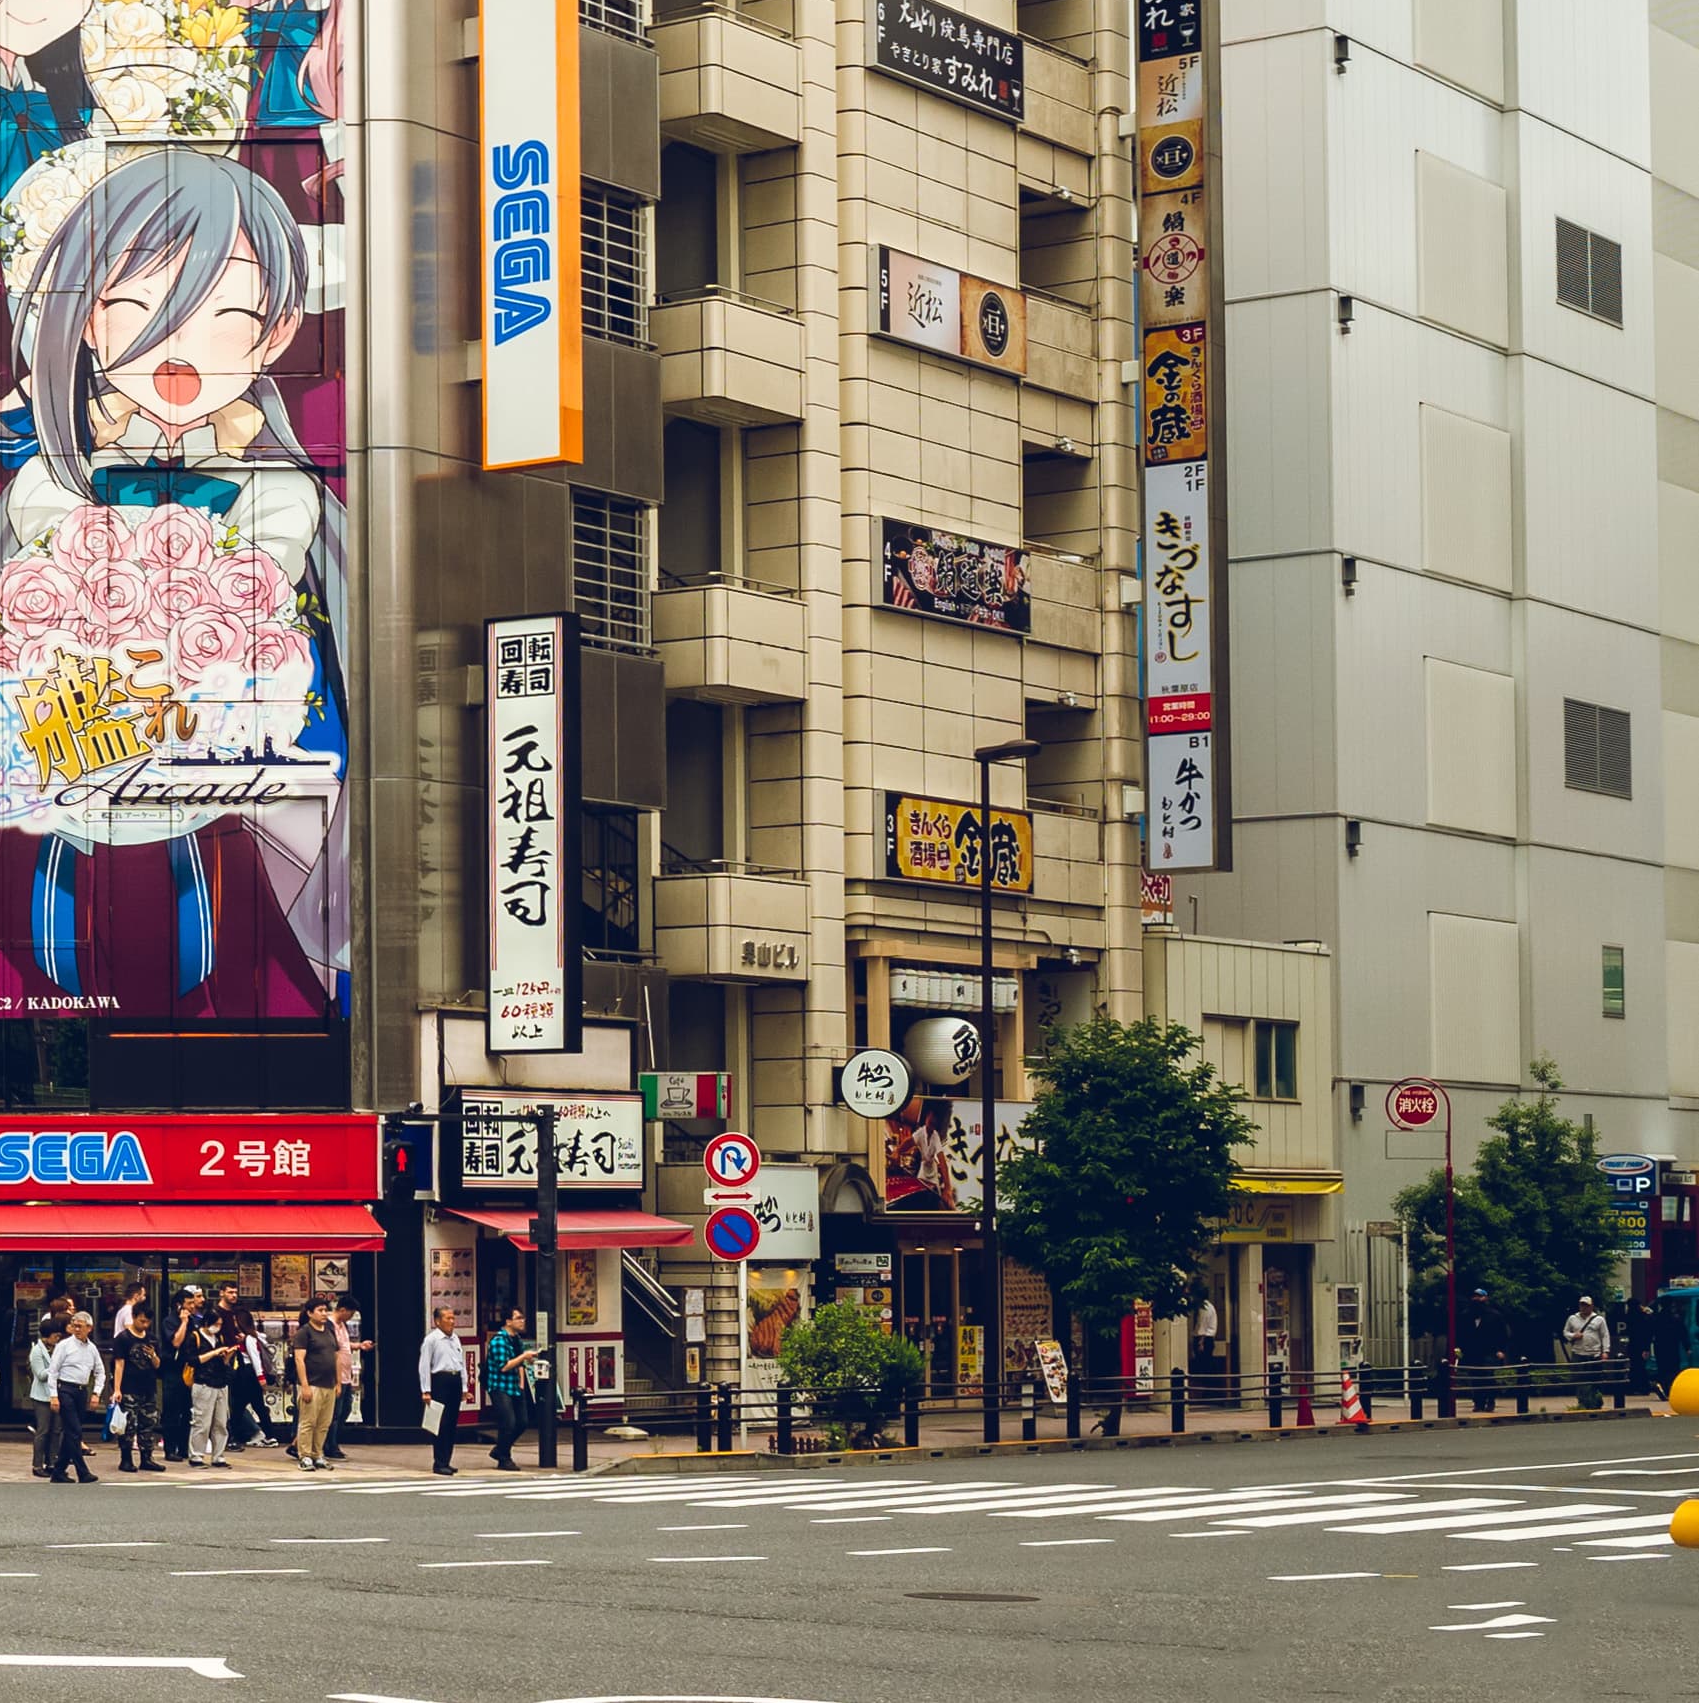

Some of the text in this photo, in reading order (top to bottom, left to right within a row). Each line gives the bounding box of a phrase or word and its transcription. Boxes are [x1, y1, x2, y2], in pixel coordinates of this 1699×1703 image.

[1179, 55, 1199, 70] 5F
[945, 56, 997, 100] すみれ
[1180, 192, 1202, 205] 4F
[493, 140, 551, 345] SEGA
[1182, 328, 1203, 341] 3F
[1147, 351, 1191, 445] 金の蔵
[1184, 464, 1204, 477] 2F
[1186, 478, 1204, 492] 1F
[1154, 511, 1205, 661] きづなすし
[501, 637, 551, 664] 回転
[500, 668, 552, 693] 寿司
[1161, 683, 1199, 693] 秋葉原店
[1189, 736, 1209, 748] B1
[55, 758, 287, 806] Arcade
[1176, 757, 1204, 831] 牛かつ
[498, 726, 554, 926] 元祖寿司
[910, 810, 952, 839] きんくら
[27, 996, 120, 1010] KADOKAWA
[511, 1024, 543, 1039] 以上
[1399, 1097, 1434, 1114] 消火栓
[199, 1140, 312, 1179] 2号館
[465, 1142, 500, 1172] 寿司
[1636, 1177, 1651, 1192] P
